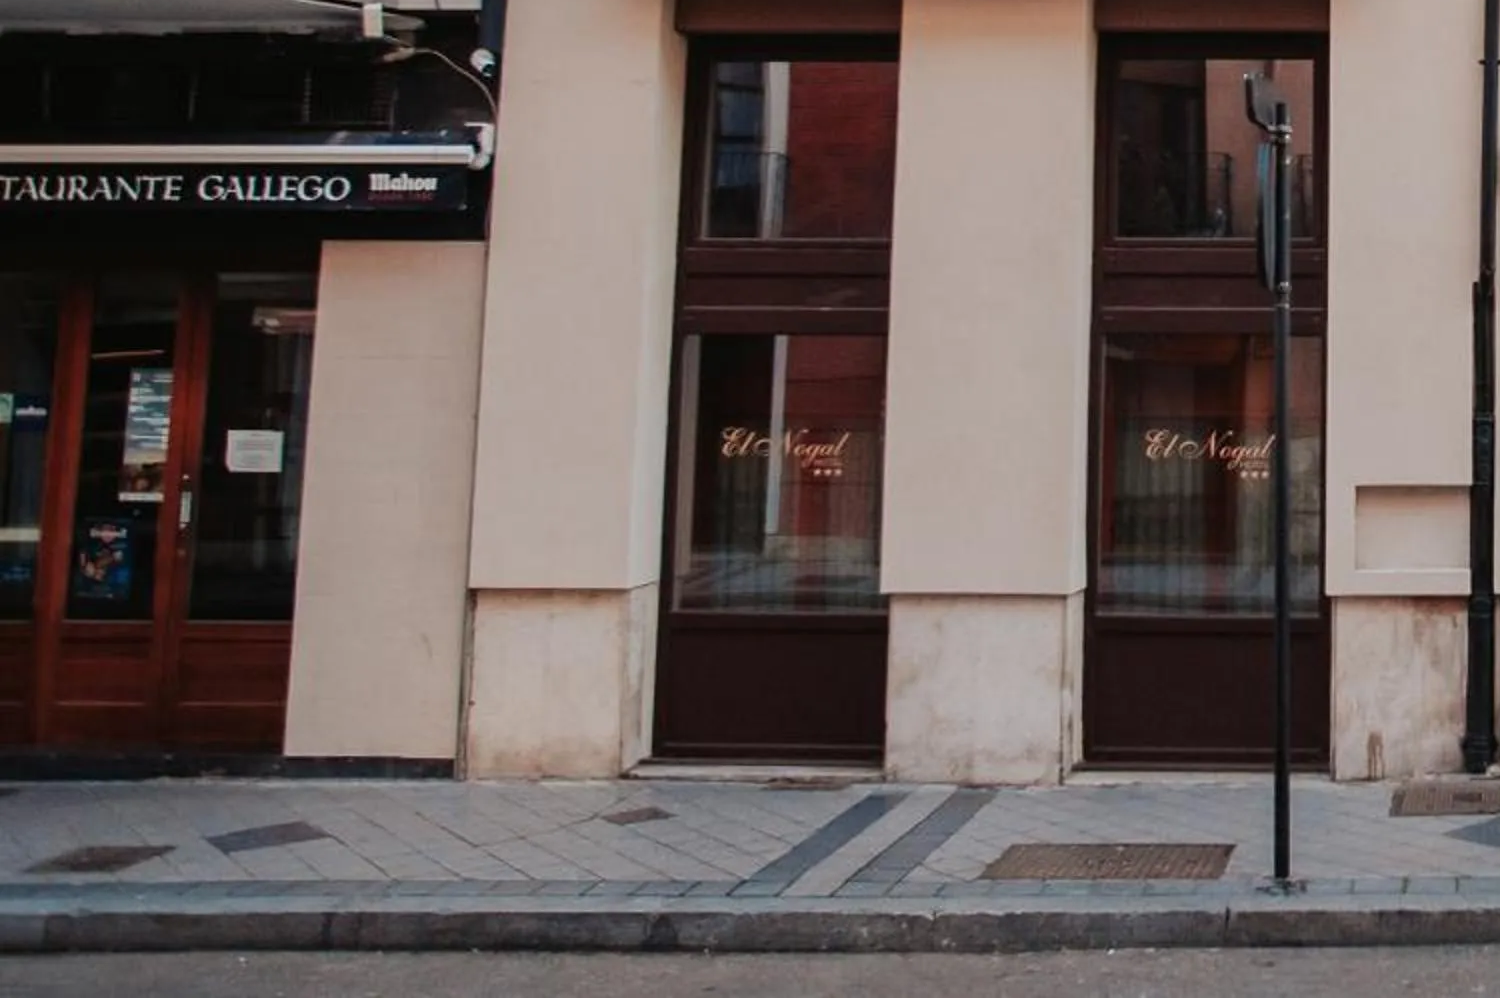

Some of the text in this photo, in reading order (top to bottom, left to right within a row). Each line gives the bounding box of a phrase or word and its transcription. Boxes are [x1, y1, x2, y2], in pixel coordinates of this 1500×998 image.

[198, 174, 351, 202] GALLEGO
[368, 171, 438, 191] Mahou
[721, 425, 852, 466] El Nogal
[1144, 429, 1276, 470] El Nogal
